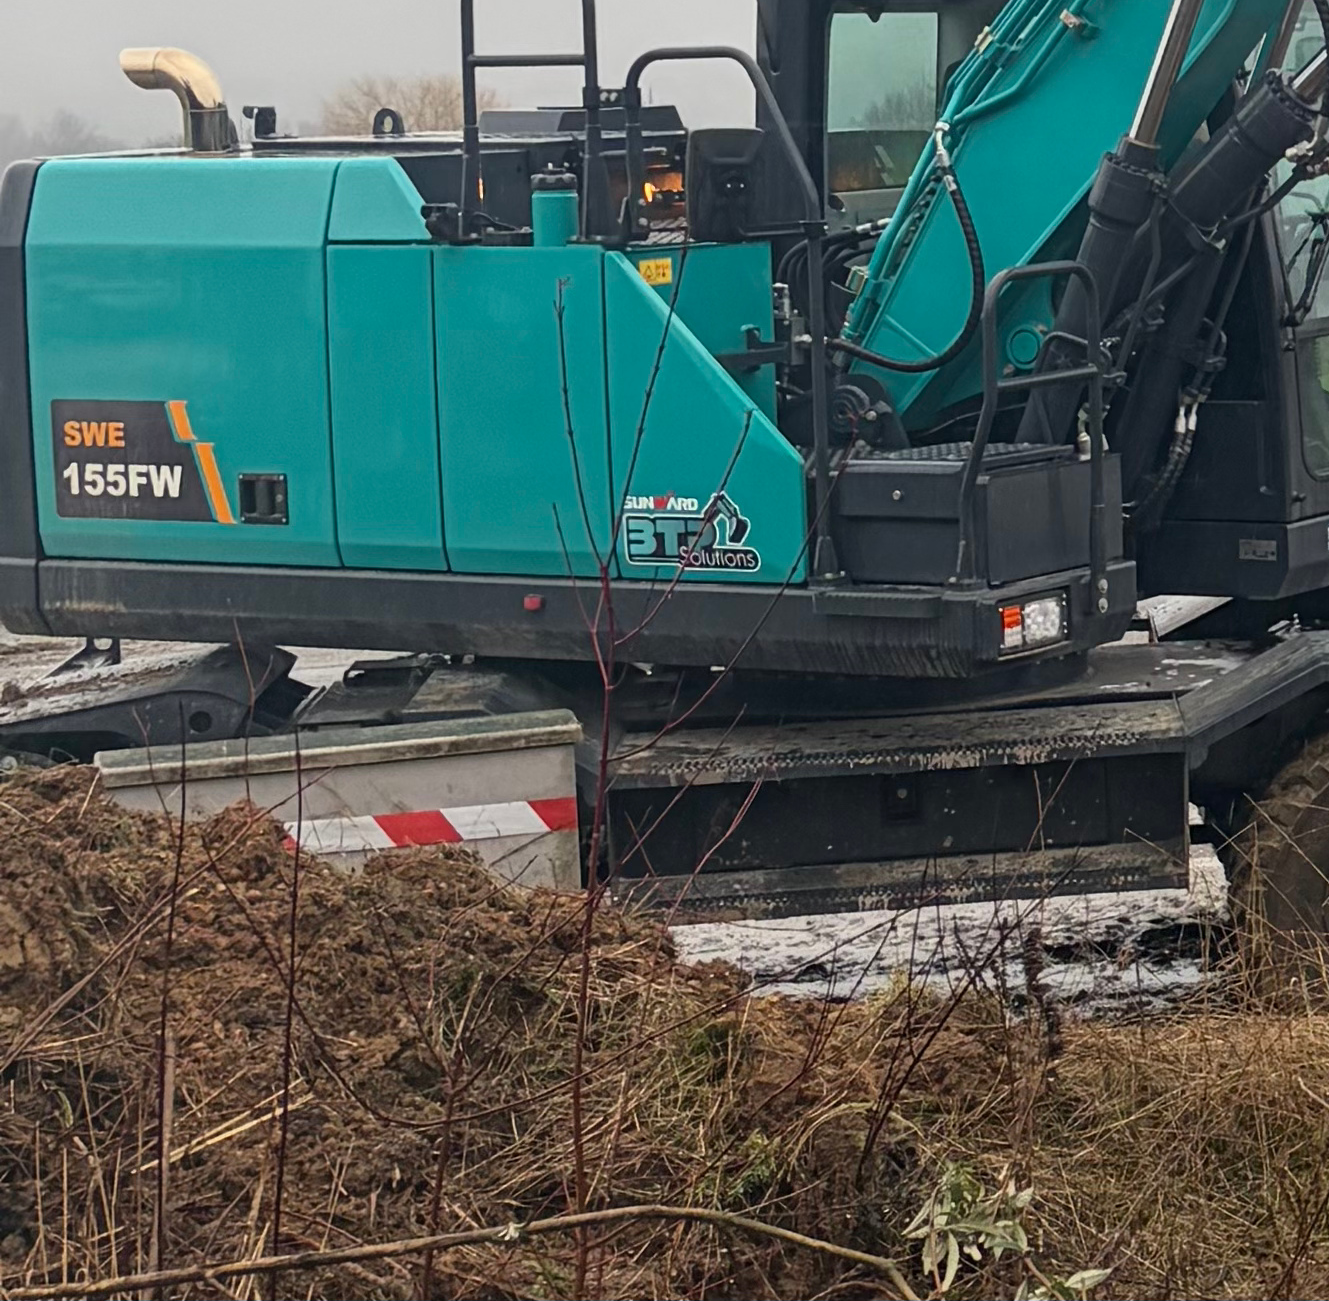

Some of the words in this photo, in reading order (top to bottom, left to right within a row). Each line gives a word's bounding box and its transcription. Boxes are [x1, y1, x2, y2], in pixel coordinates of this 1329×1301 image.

[64, 421, 125, 447] SWE
[63, 462, 183, 498] 155FW
[679, 545, 756, 568] Solutions
